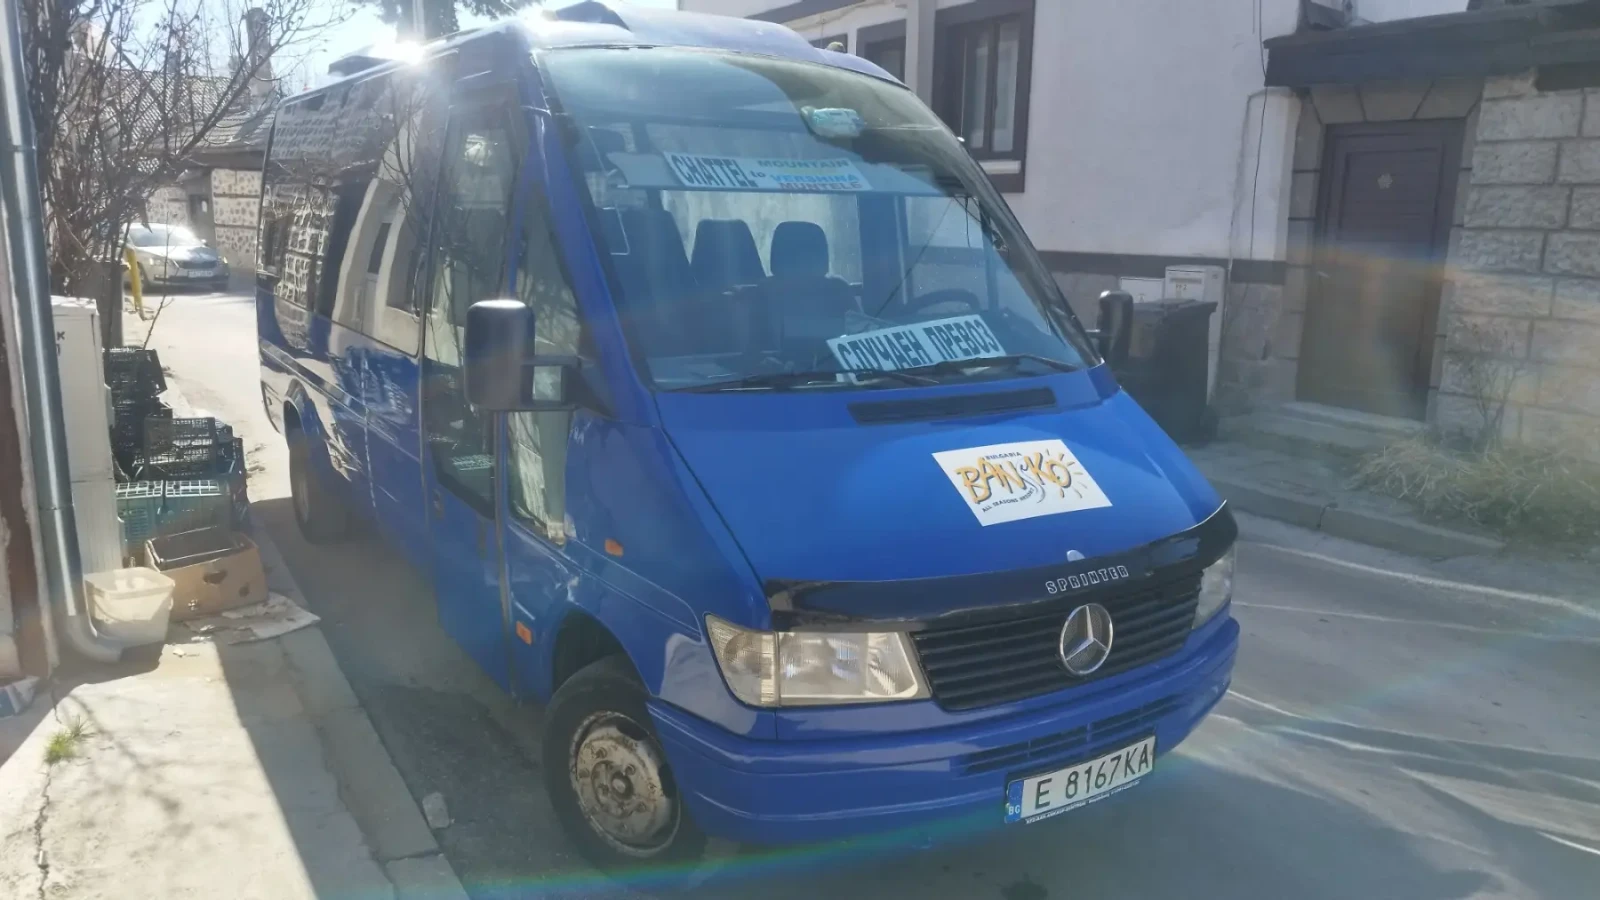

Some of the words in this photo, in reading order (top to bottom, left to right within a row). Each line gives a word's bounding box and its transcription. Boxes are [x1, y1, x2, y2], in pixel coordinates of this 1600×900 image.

[670, 154, 760, 188] CHATTEL
[769, 173, 860, 183] VERSHINA
[836, 329, 933, 371] СЛУЧАЕН
[922, 319, 1001, 360] ПРЕВОЗ
[984, 451, 1022, 461] BULGARIA
[954, 451, 1072, 505] BANSKO
[1045, 565, 1129, 594] SPRINTER
[1035, 778, 1053, 810] E
[1065, 743, 1149, 800] 8167KA
[1008, 804, 1021, 816] BG
